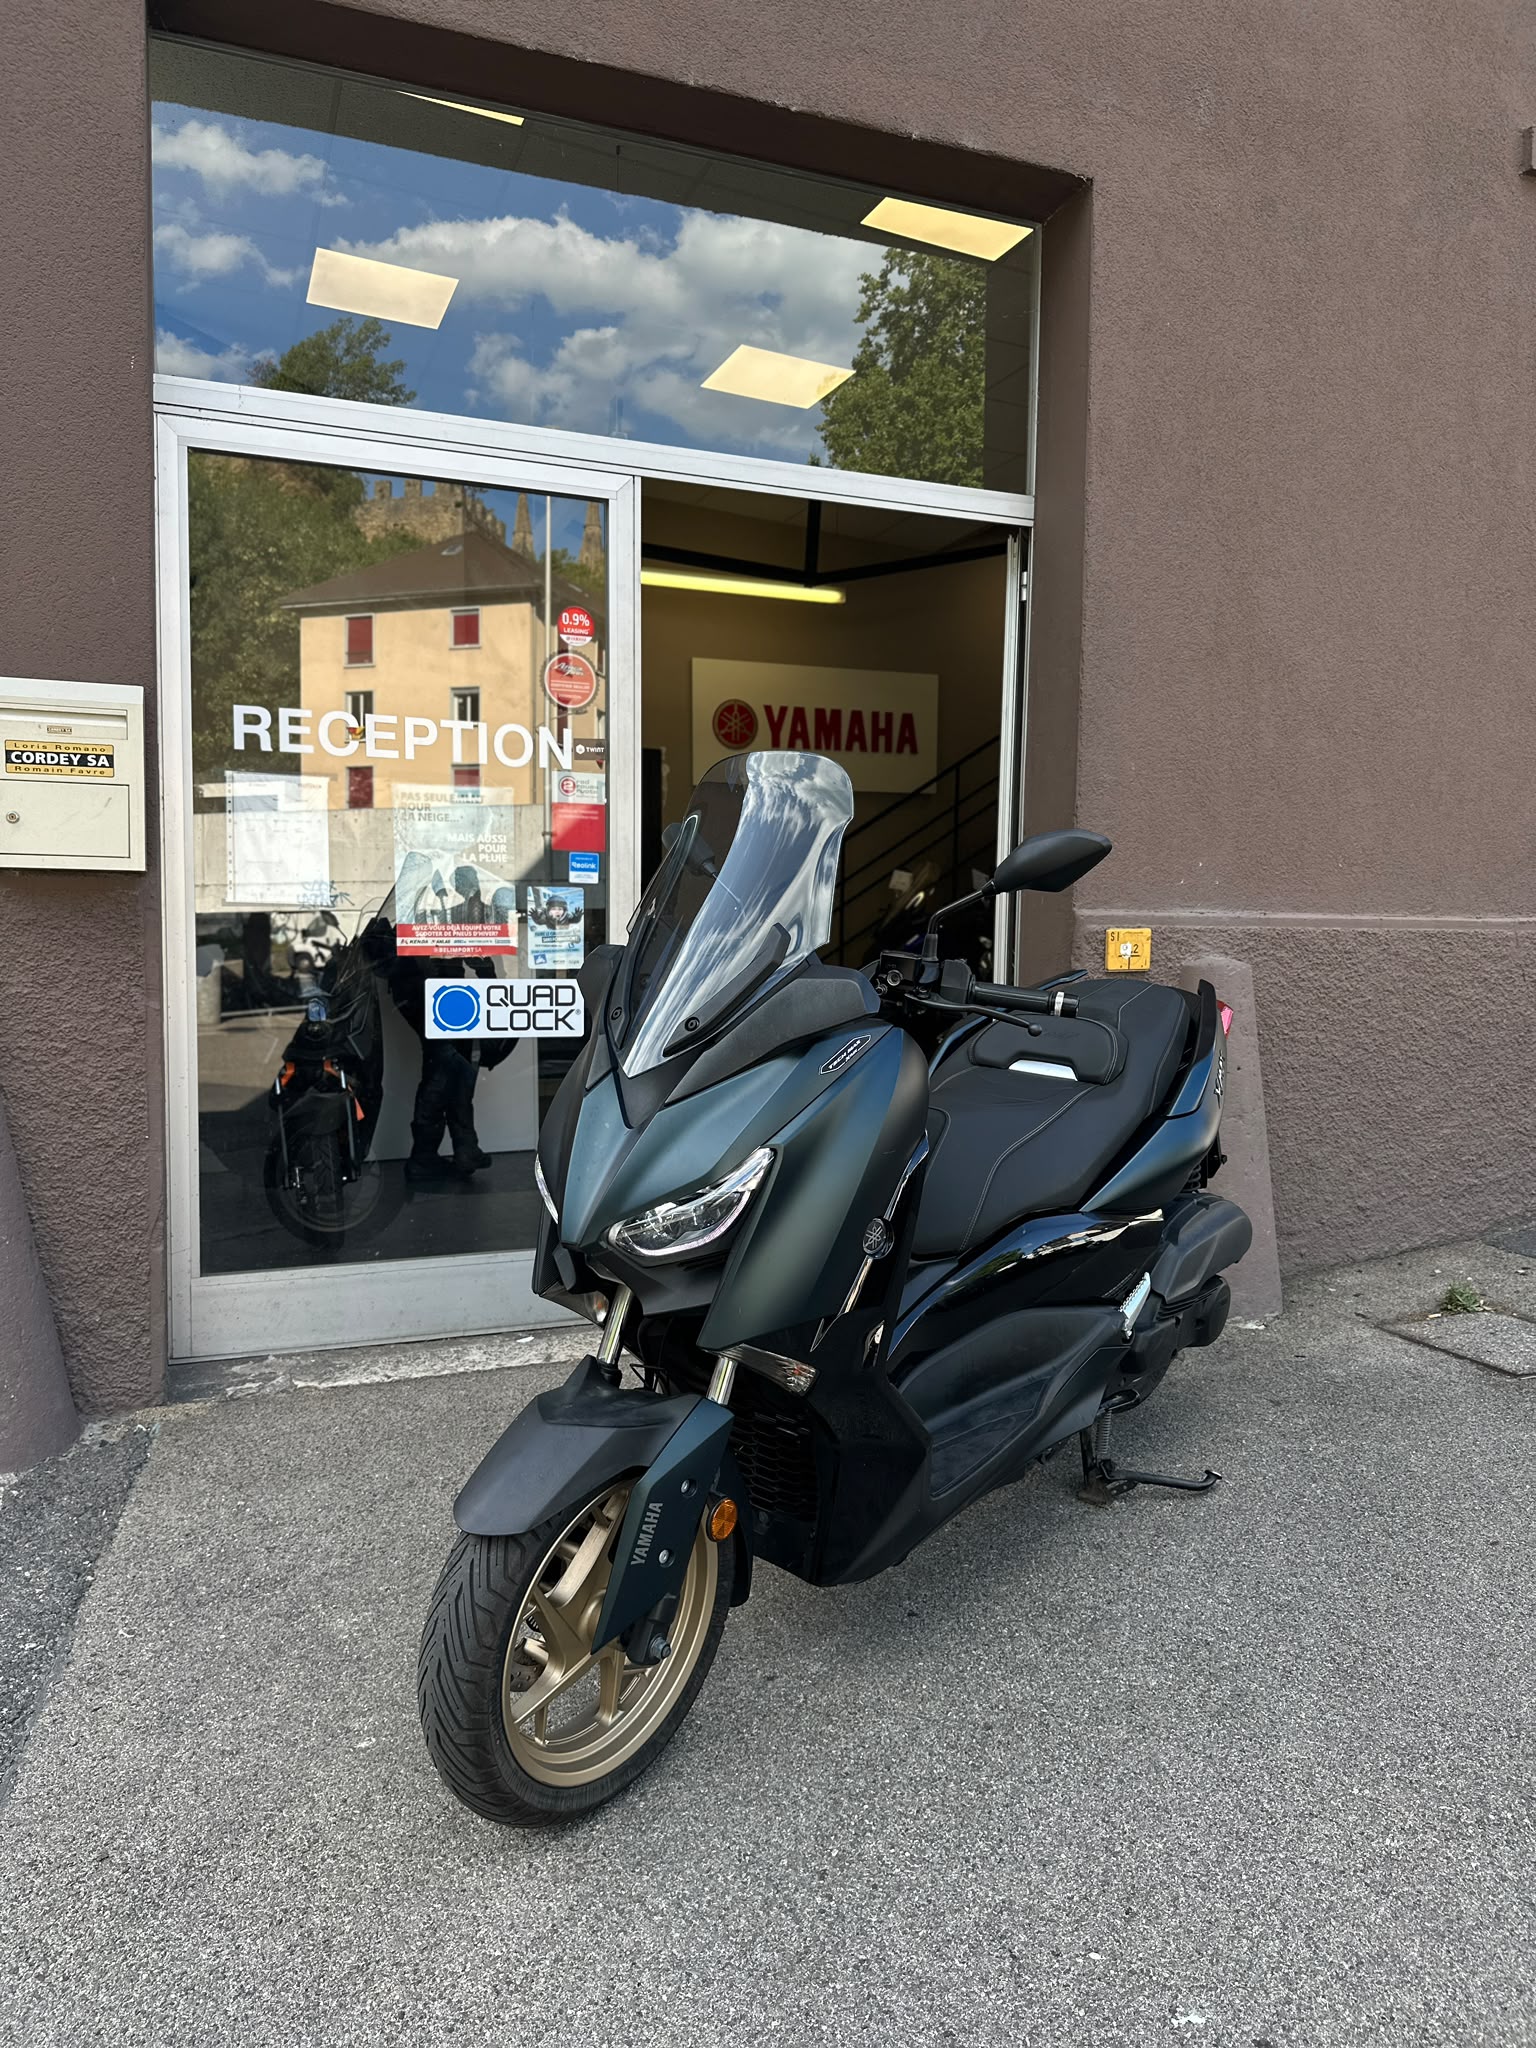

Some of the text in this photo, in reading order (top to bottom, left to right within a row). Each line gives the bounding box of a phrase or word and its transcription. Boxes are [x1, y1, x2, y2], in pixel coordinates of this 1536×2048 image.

[561, 612, 590, 627] 0.9%
[232, 704, 573, 769] RECEPTION
[763, 704, 918, 754] YAMAHA
[14, 742, 106, 752] Loris Romano
[10, 751, 109, 767] CORDEY SA
[400, 792, 420, 801] PAS
[447, 832, 507, 843] MAIS AUSSI
[478, 843, 508, 853] POUR
[463, 852, 508, 863] LA PLUIE
[486, 985, 576, 1007] QUAD
[630, 1502, 664, 1565] YAMAHA
